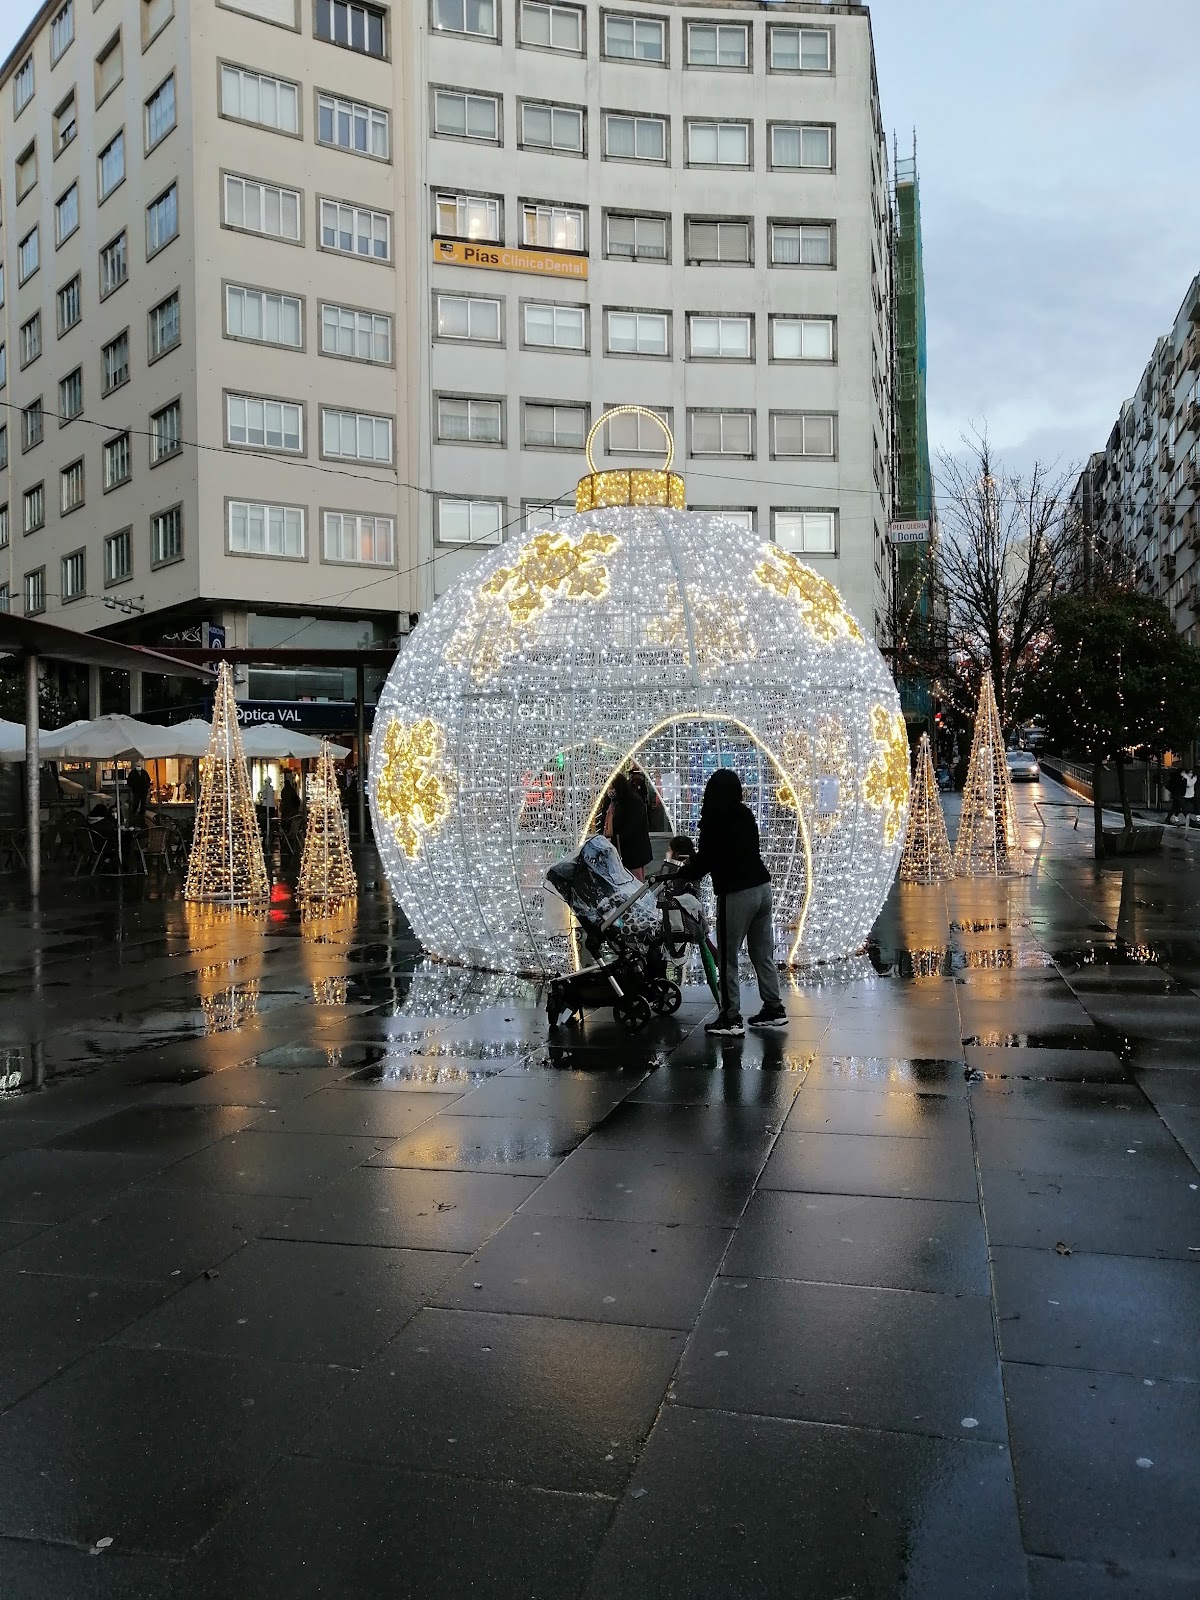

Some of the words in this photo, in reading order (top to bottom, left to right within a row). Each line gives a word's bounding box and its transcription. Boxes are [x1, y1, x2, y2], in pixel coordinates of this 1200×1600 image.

[464, 247, 499, 264] Pías
[502, 253, 543, 270] Clínica
[545, 258, 584, 274] Dental
[897, 532, 924, 541] Doma
[278, 709, 302, 722] VAL
